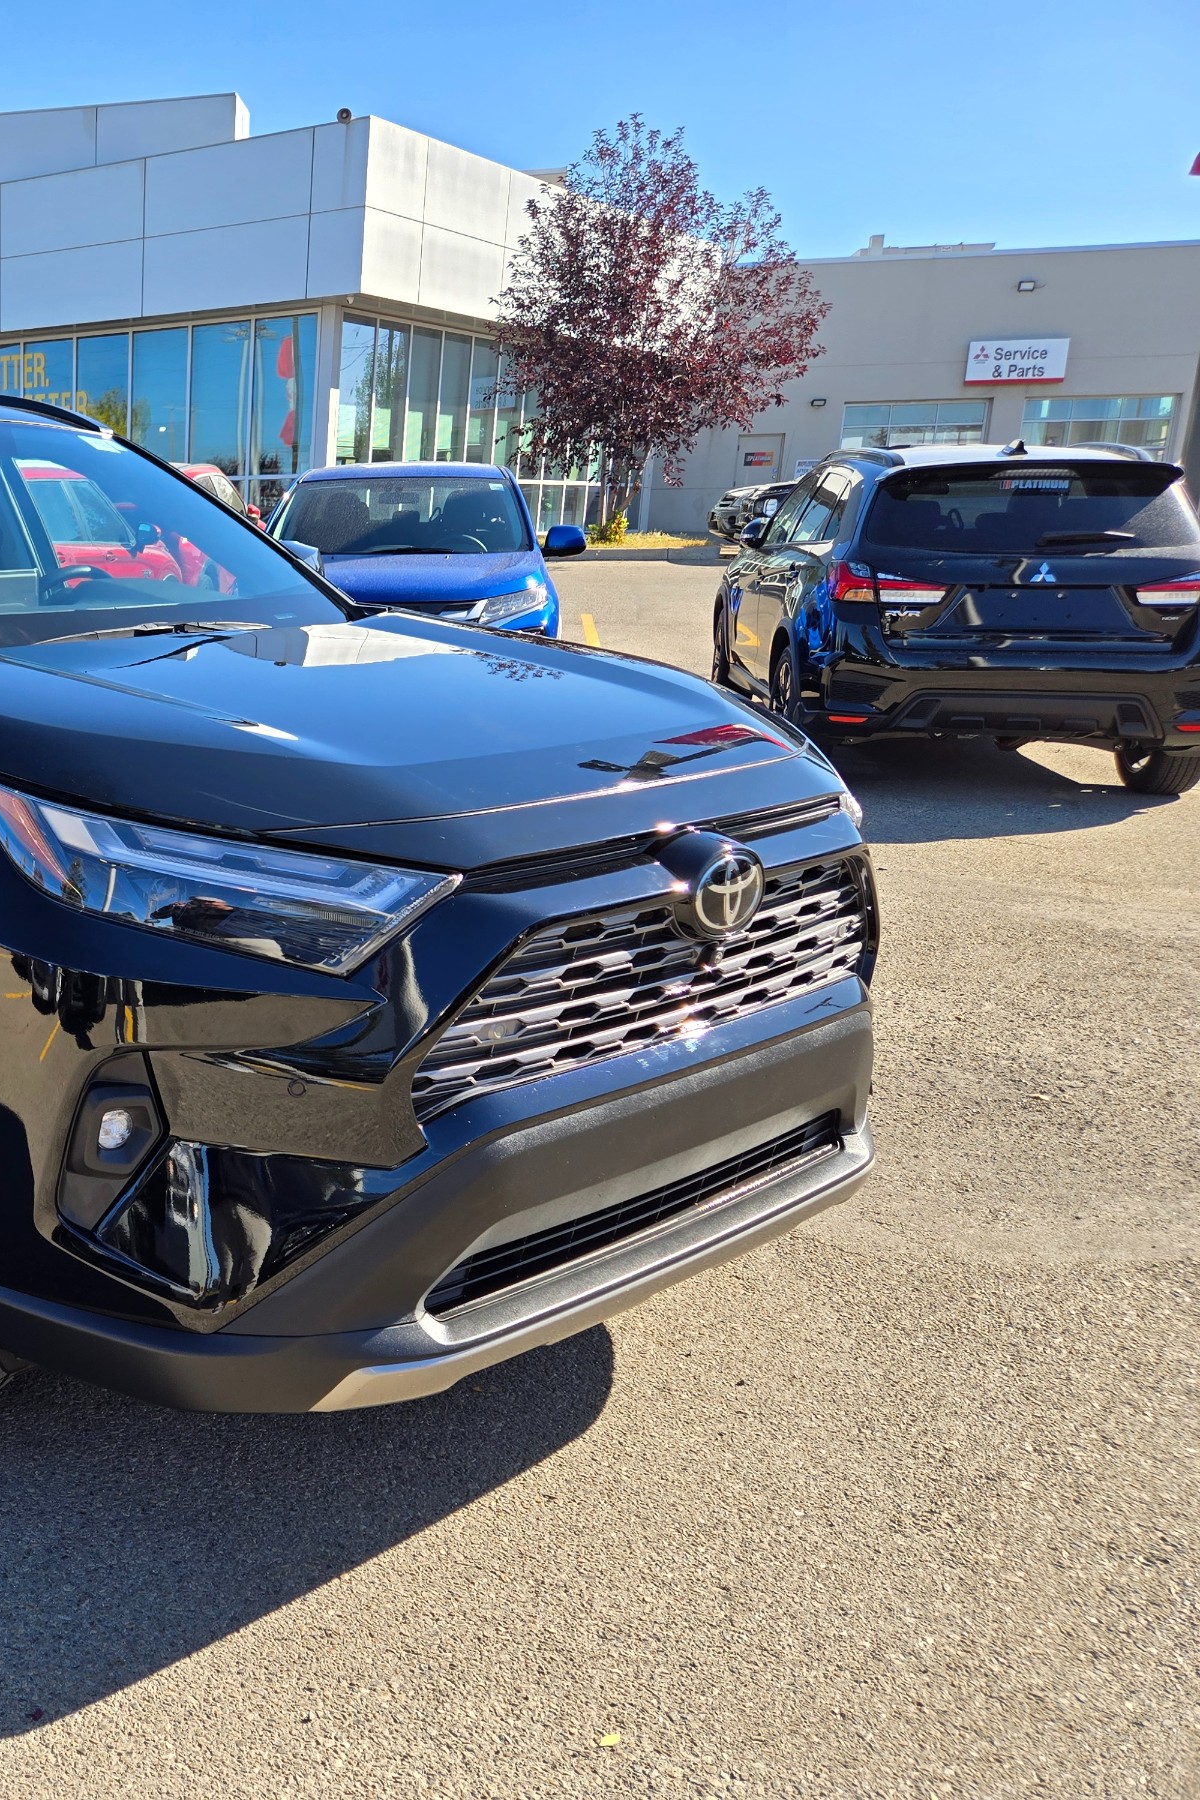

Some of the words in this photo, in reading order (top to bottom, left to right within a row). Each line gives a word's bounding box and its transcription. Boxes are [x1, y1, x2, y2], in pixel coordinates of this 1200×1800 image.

[993, 346, 1048, 361] Service
[992, 364, 1002, 378] &
[1007, 364, 1045, 378] Parts
[1010, 479, 1069, 489] PLATINUM
